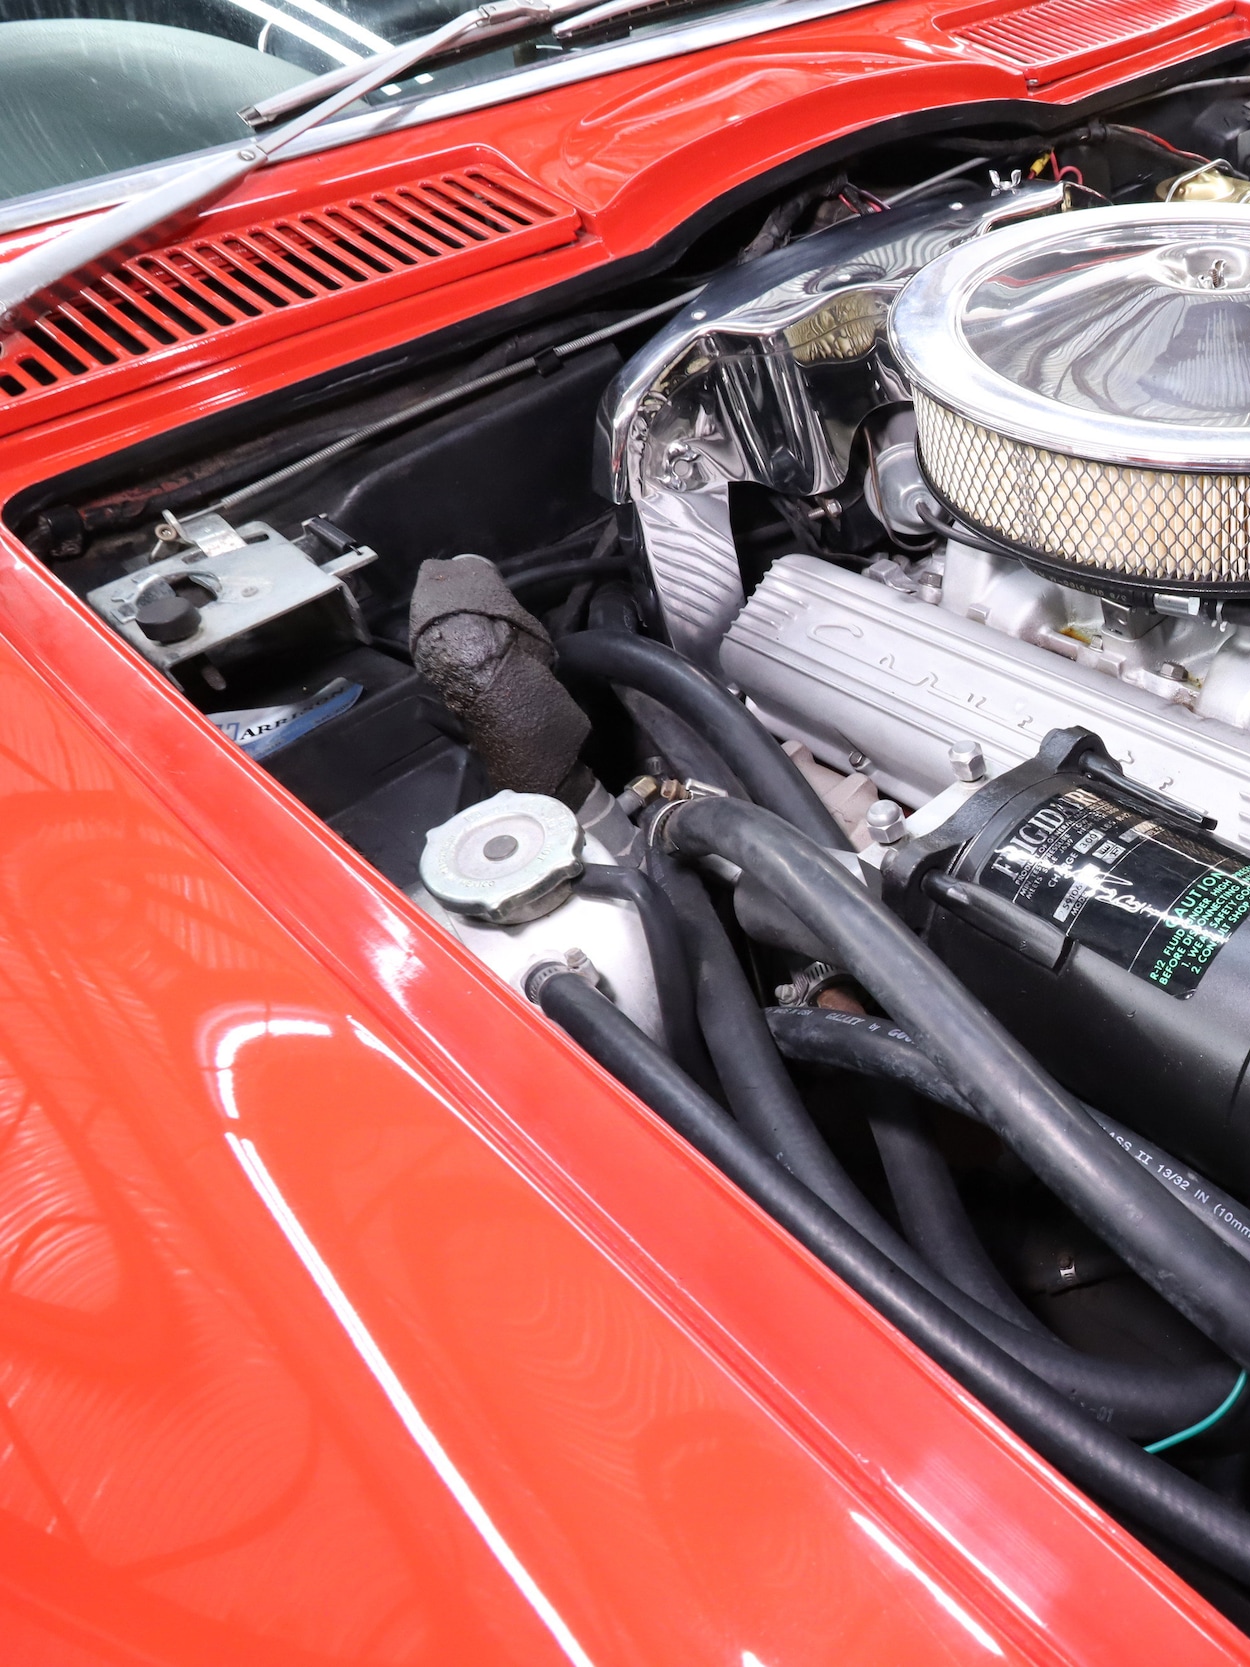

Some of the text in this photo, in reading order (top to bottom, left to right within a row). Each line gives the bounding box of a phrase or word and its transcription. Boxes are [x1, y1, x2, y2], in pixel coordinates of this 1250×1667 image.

[1046, 849, 1079, 889] CHRGE
[1165, 867, 1224, 929] CAUTION
[1148, 957, 1167, 981] R-12
[1162, 927, 1186, 957] FLUID
[1210, 877, 1233, 897] HIGH
[1157, 945, 1187, 986] BEFORE
[1182, 883, 1240, 947] DISONNECTING
[1180, 958, 1192, 969] 1.
[1208, 898, 1238, 929] SAFETY
[1189, 962, 1203, 976] 2.
[868, 1022, 882, 1032] by
[1134, 1149, 1154, 1166] II
[1156, 1163, 1191, 1191] 13/32
[1194, 1189, 1210, 1205] IN
